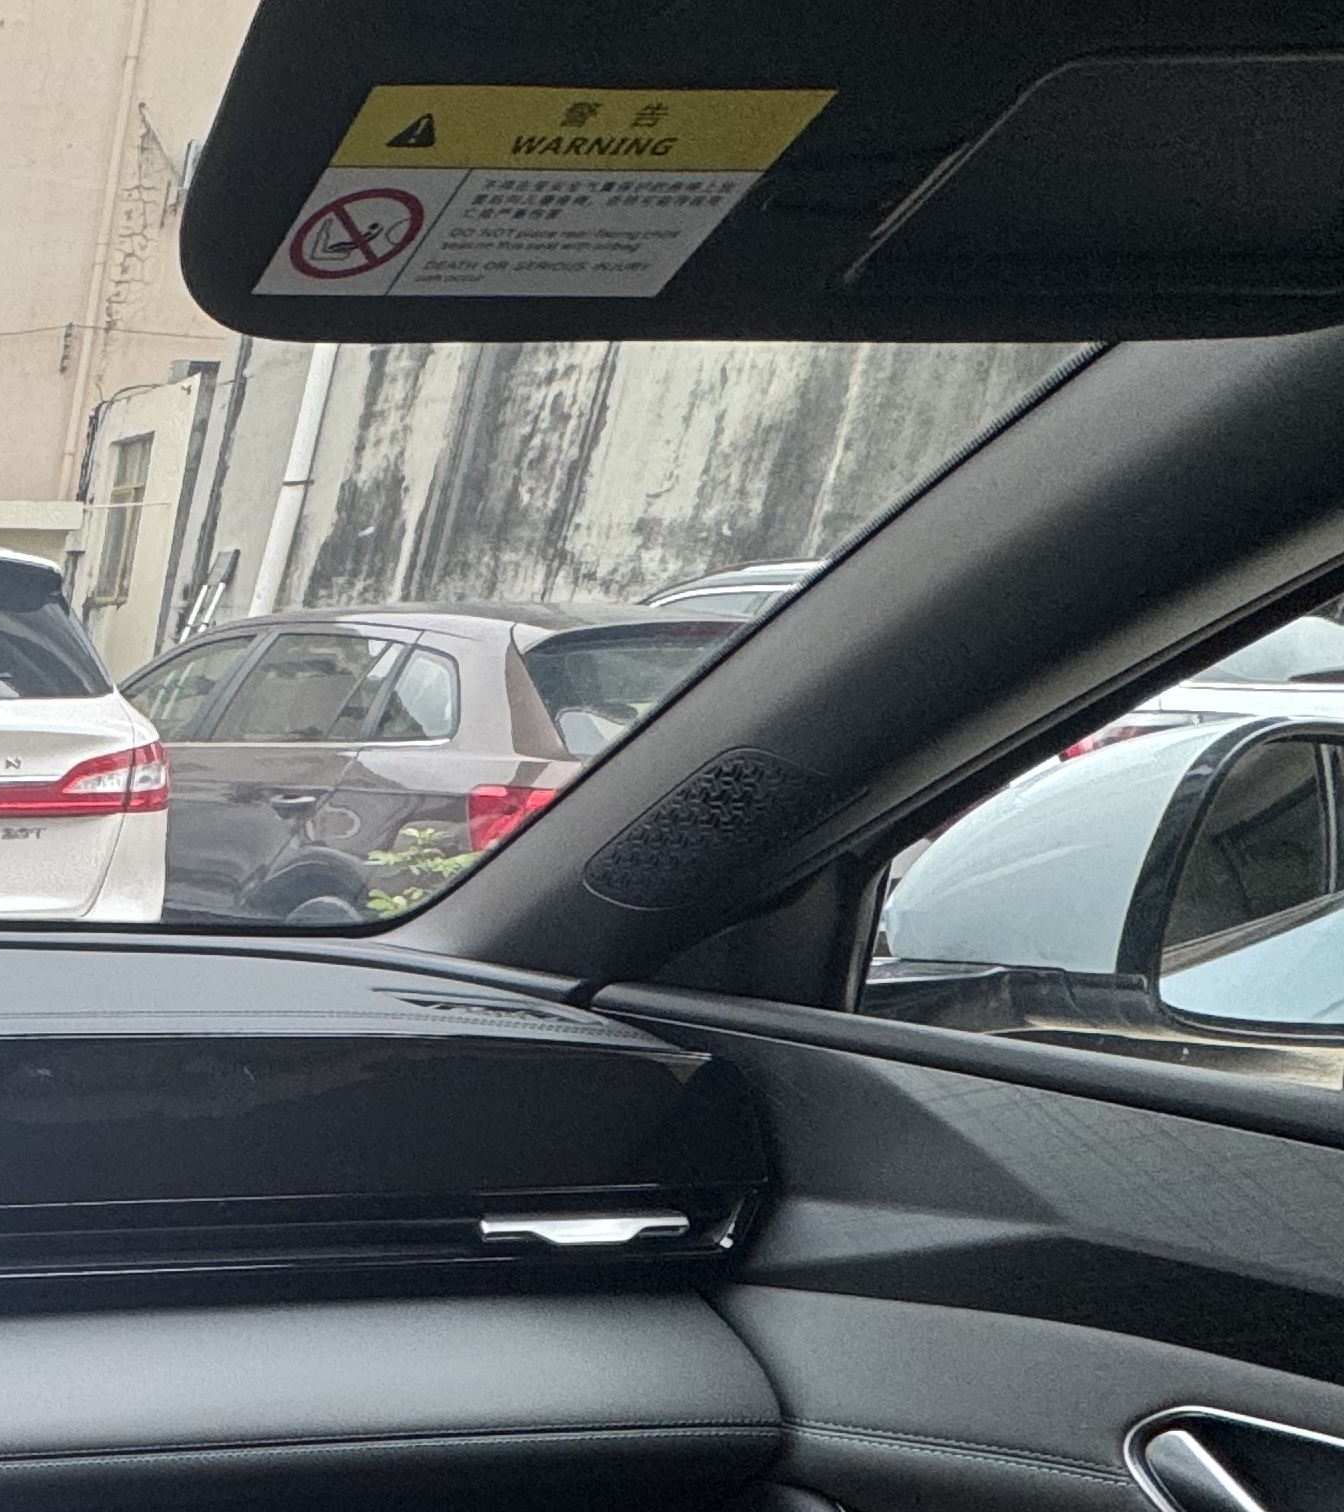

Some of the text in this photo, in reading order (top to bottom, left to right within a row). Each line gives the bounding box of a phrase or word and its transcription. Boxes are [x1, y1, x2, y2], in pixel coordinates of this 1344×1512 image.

[511, 135, 679, 156] WARNING
[423, 261, 479, 271] DEATH
[483, 261, 509, 271] OR
[513, 261, 586, 271] SERIOUS
